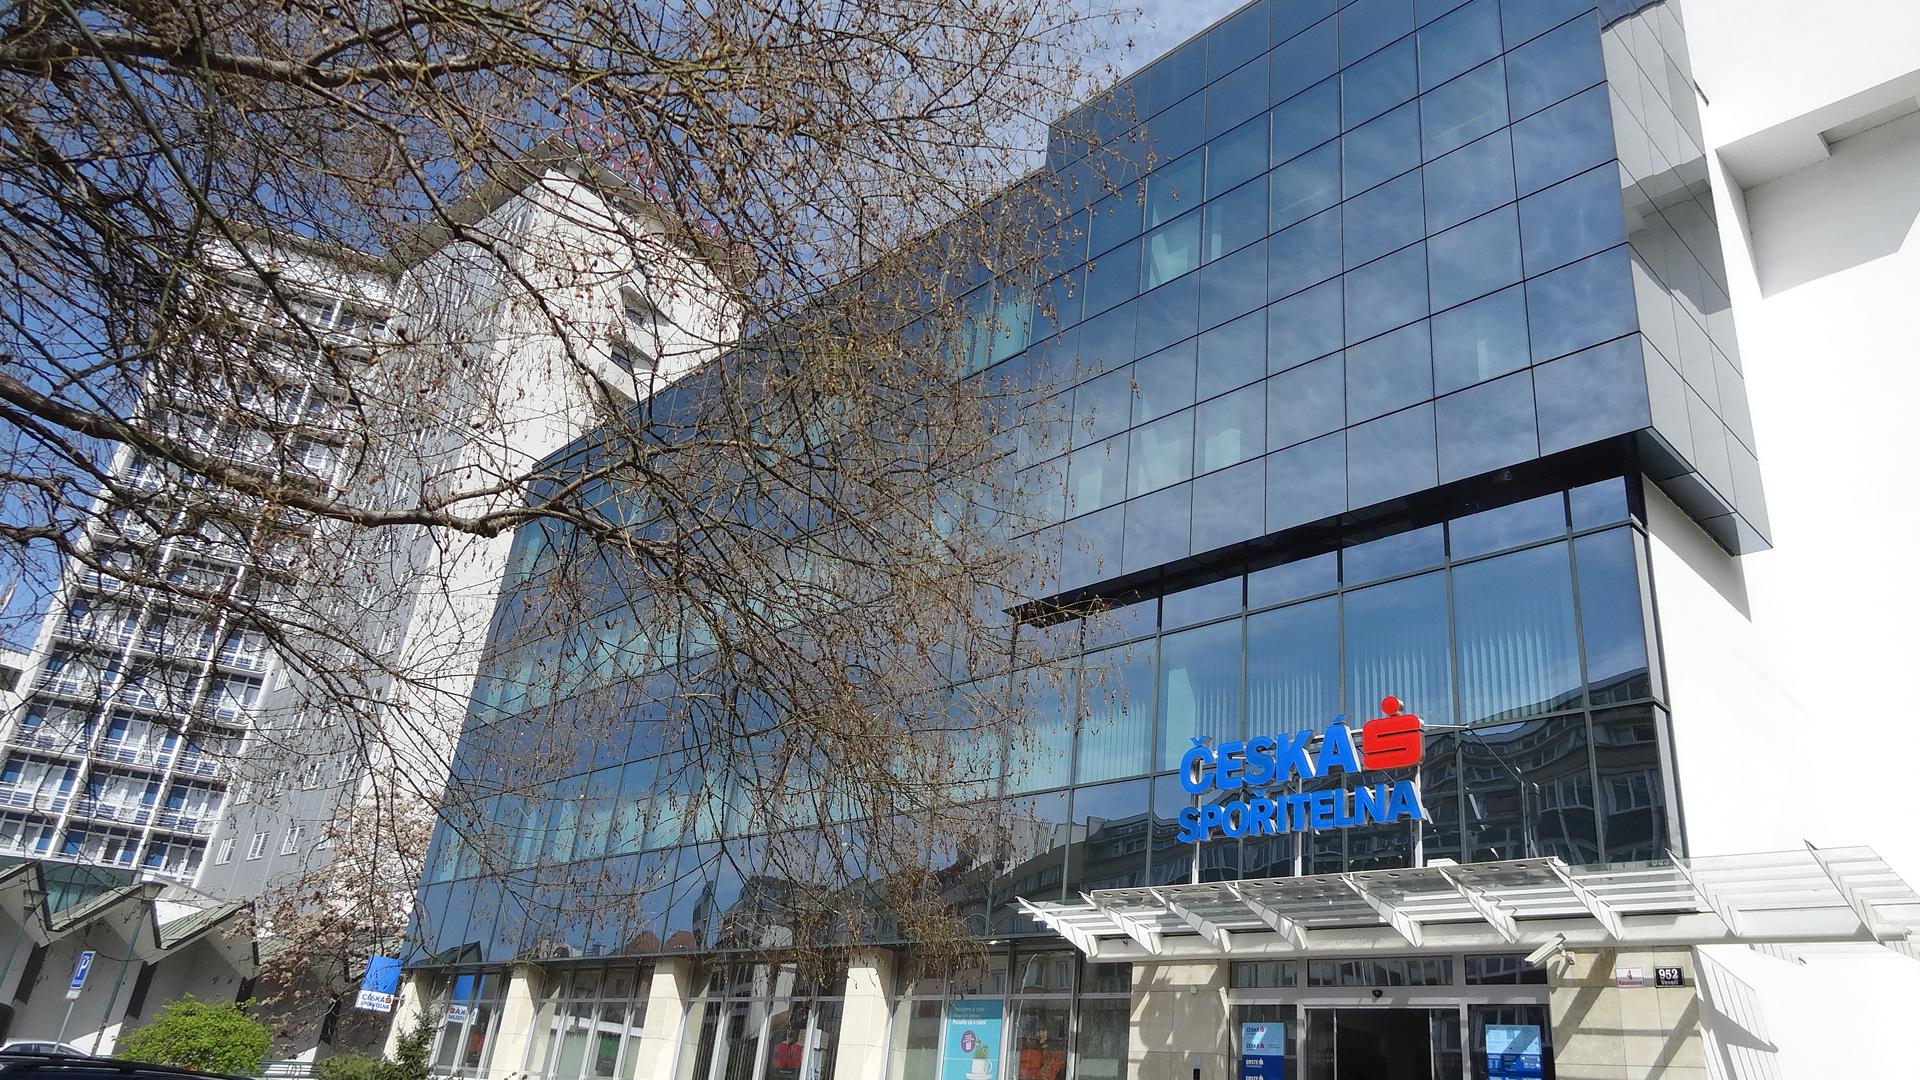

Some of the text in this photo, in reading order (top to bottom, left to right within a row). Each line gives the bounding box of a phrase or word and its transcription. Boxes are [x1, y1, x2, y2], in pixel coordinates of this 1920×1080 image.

[1179, 714, 1360, 795] ČESKÁ
[1176, 780, 1425, 844] SPOŘITELNA
[1626, 969, 1632, 979] 4
[1658, 968, 1679, 979] 952
